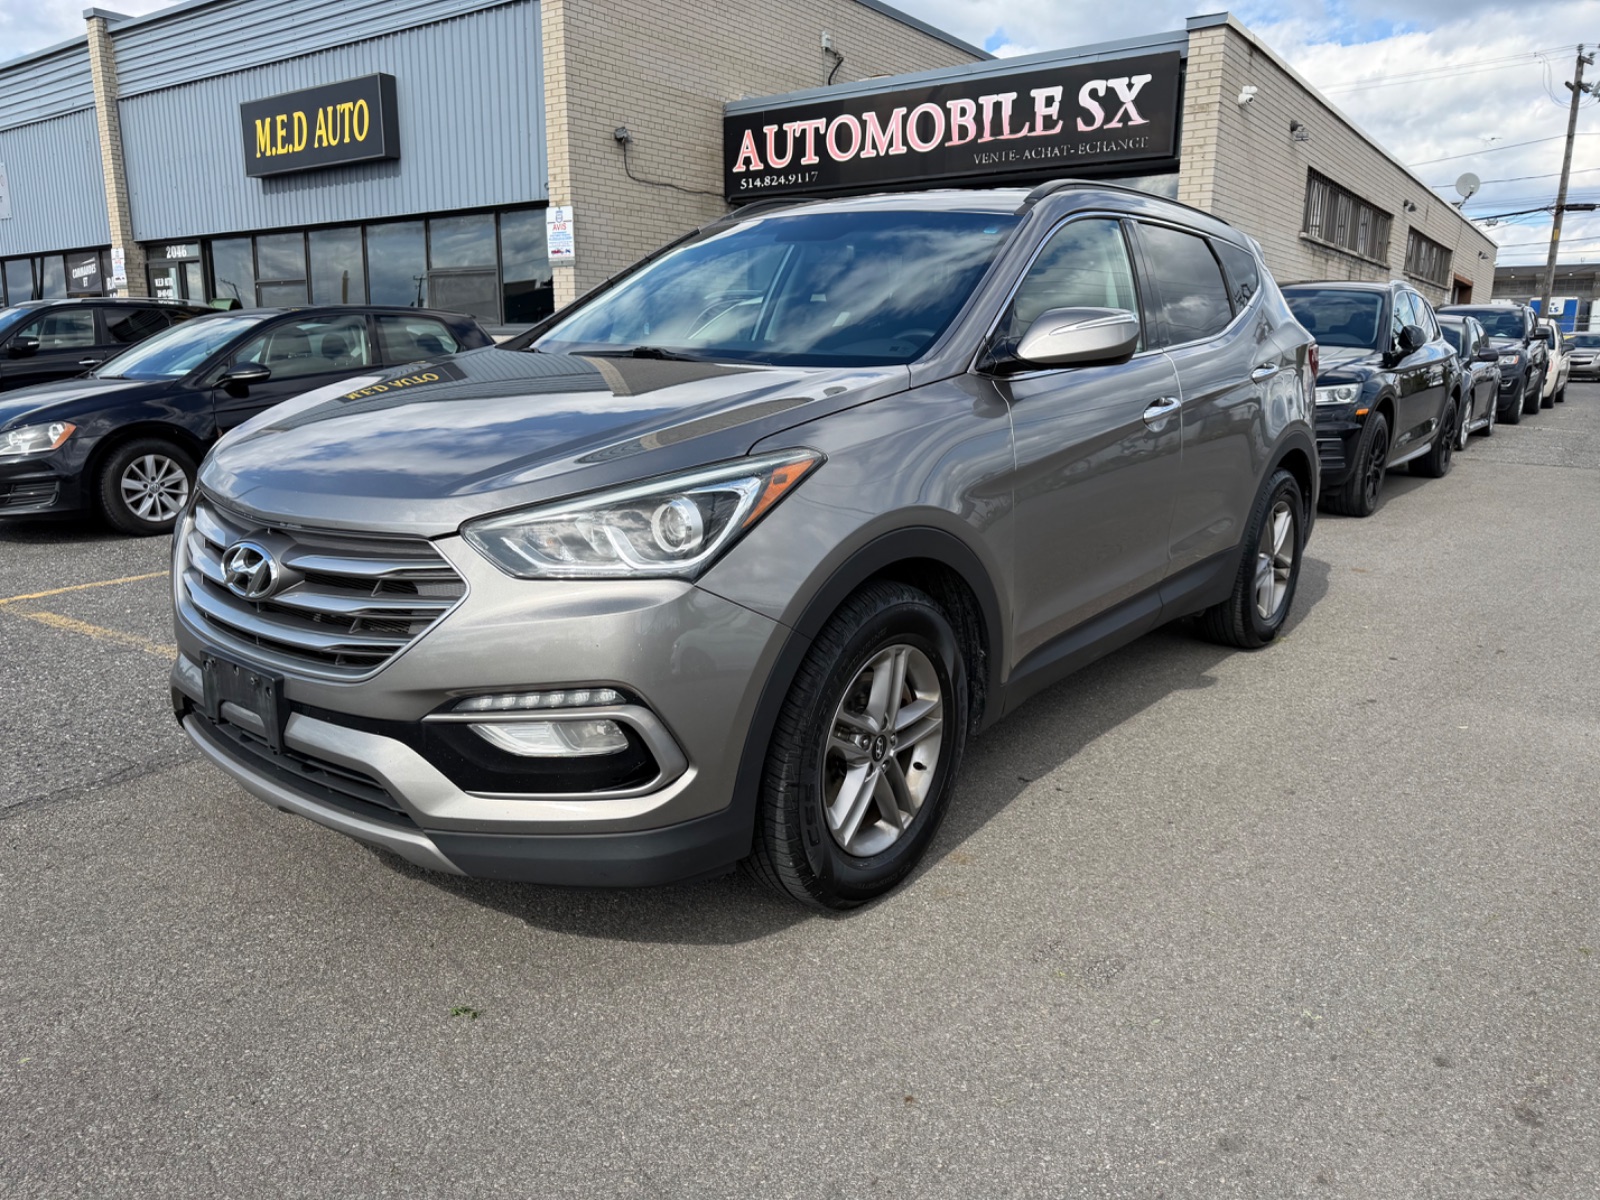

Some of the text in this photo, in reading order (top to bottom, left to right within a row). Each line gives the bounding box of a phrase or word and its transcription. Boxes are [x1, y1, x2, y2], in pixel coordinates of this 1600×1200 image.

[255, 99, 370, 158] M.E.D AUTO
[733, 74, 1152, 173] AUTOMOBILE SX
[740, 171, 818, 190] 514.824.9117
[165, 245, 187, 259] 2046
